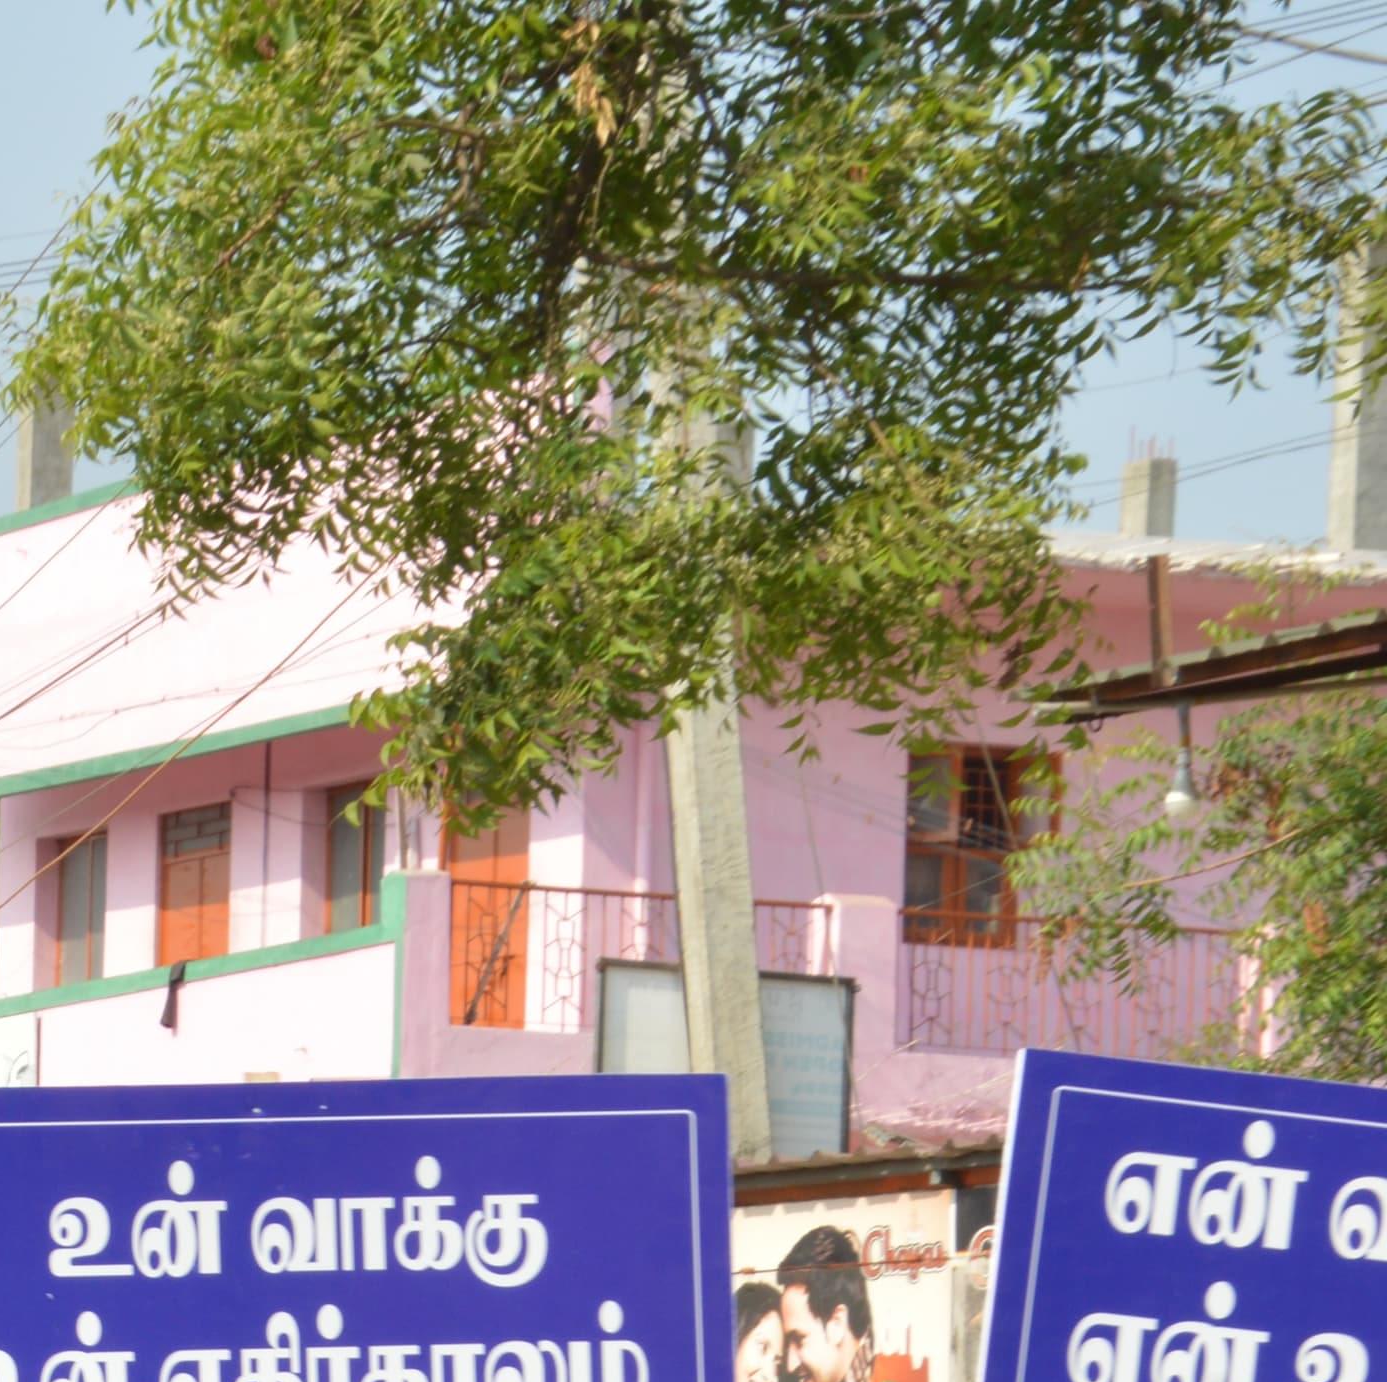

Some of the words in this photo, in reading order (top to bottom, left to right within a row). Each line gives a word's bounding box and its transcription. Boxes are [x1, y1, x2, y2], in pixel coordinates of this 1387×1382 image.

[48, 1159, 228, 1278] உன்
[250, 1154, 549, 1288] வாக்கு
[1104, 1119, 1310, 1251] என்
